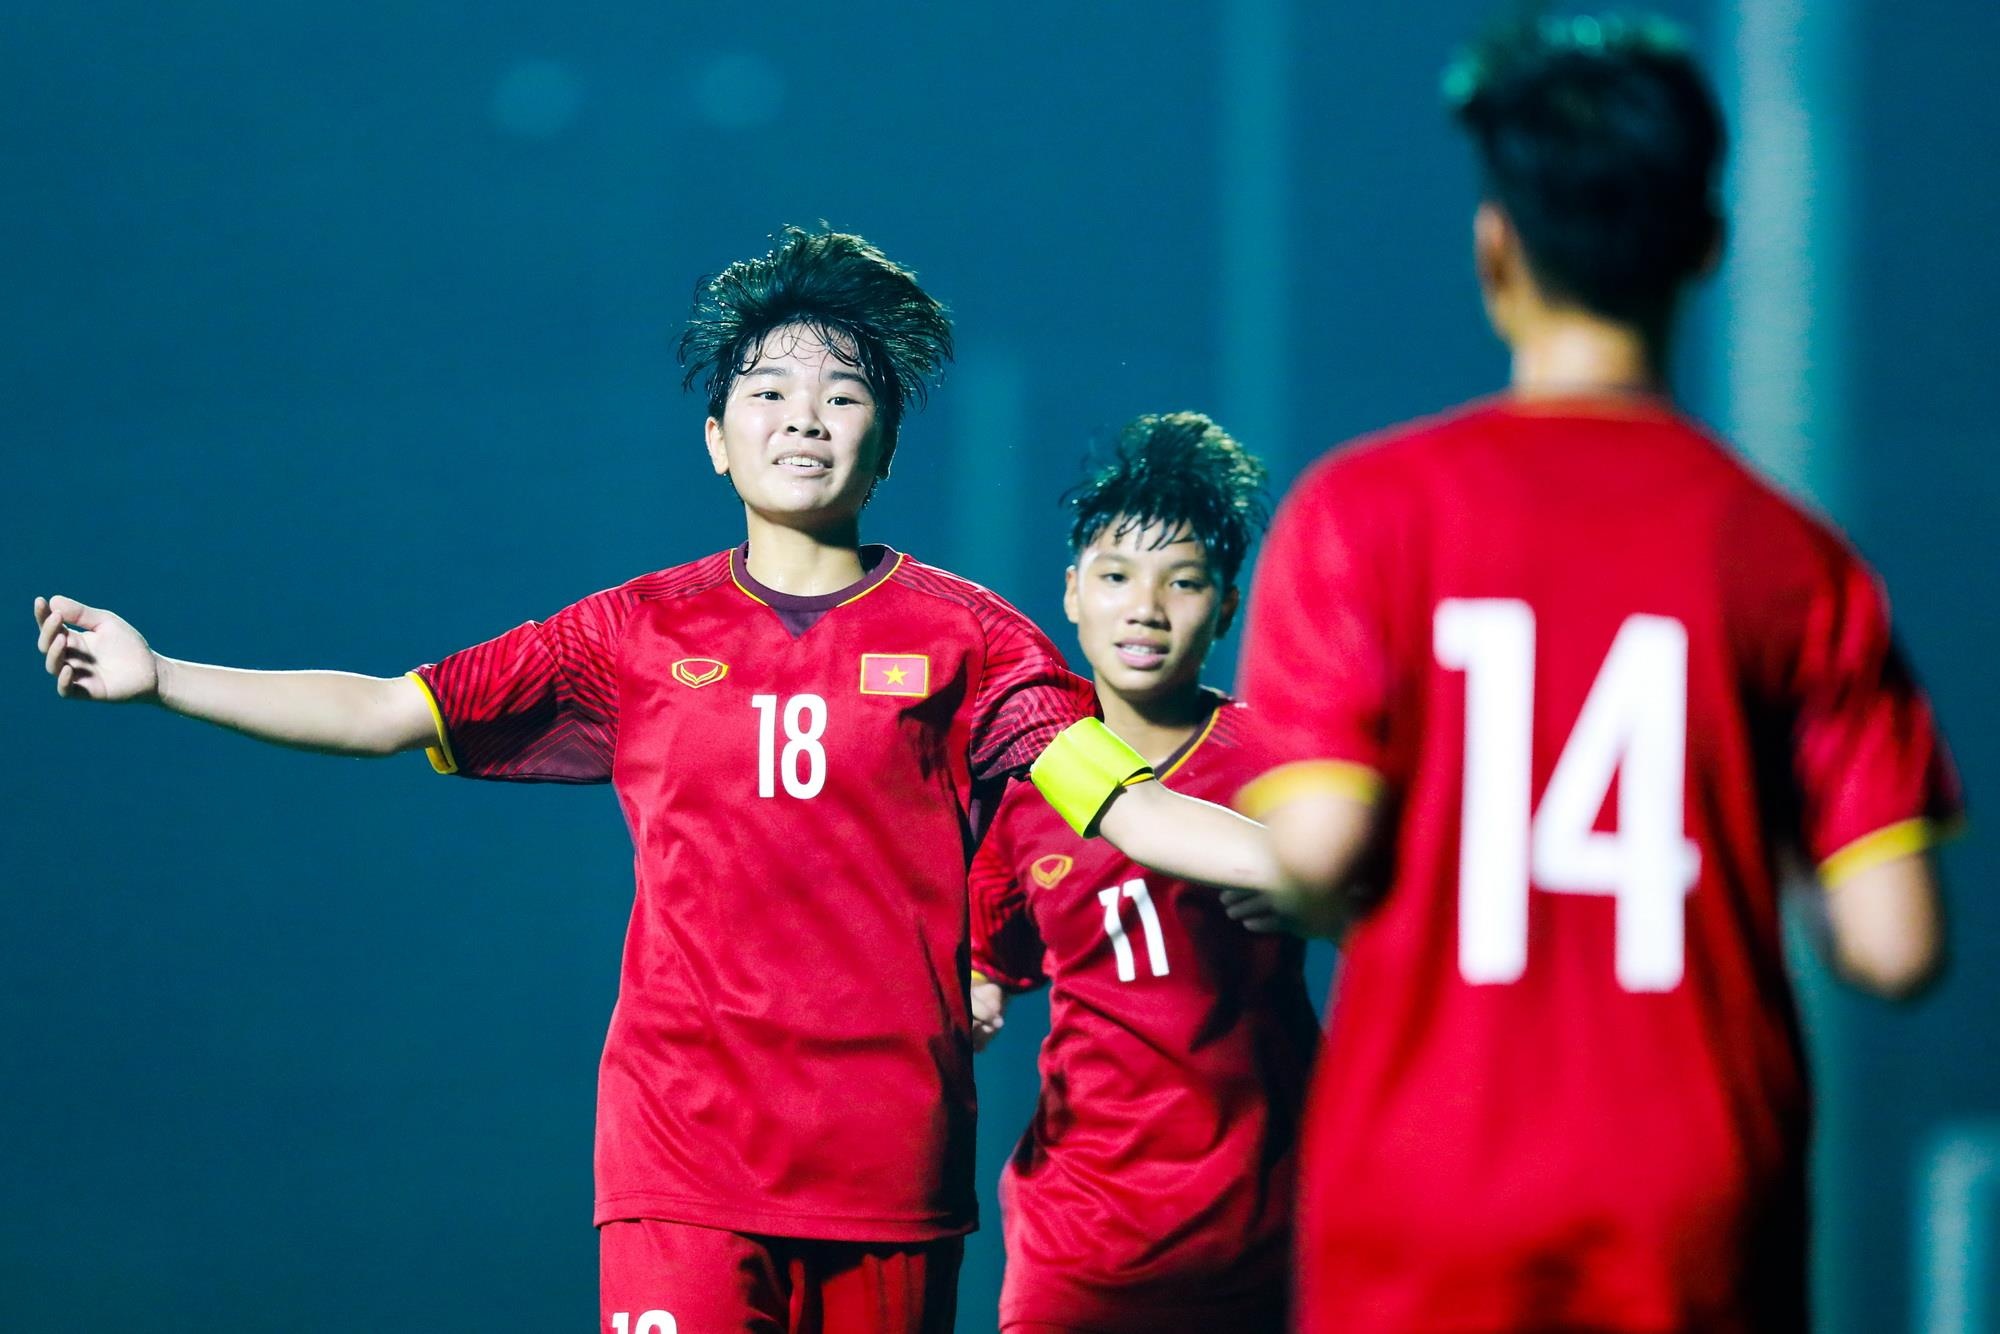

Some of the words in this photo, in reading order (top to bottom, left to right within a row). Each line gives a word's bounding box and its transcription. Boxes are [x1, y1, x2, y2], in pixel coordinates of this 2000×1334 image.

[749, 692, 828, 800] 18
[1433, 598, 1701, 992] 14
[1097, 878, 1170, 983] 11
